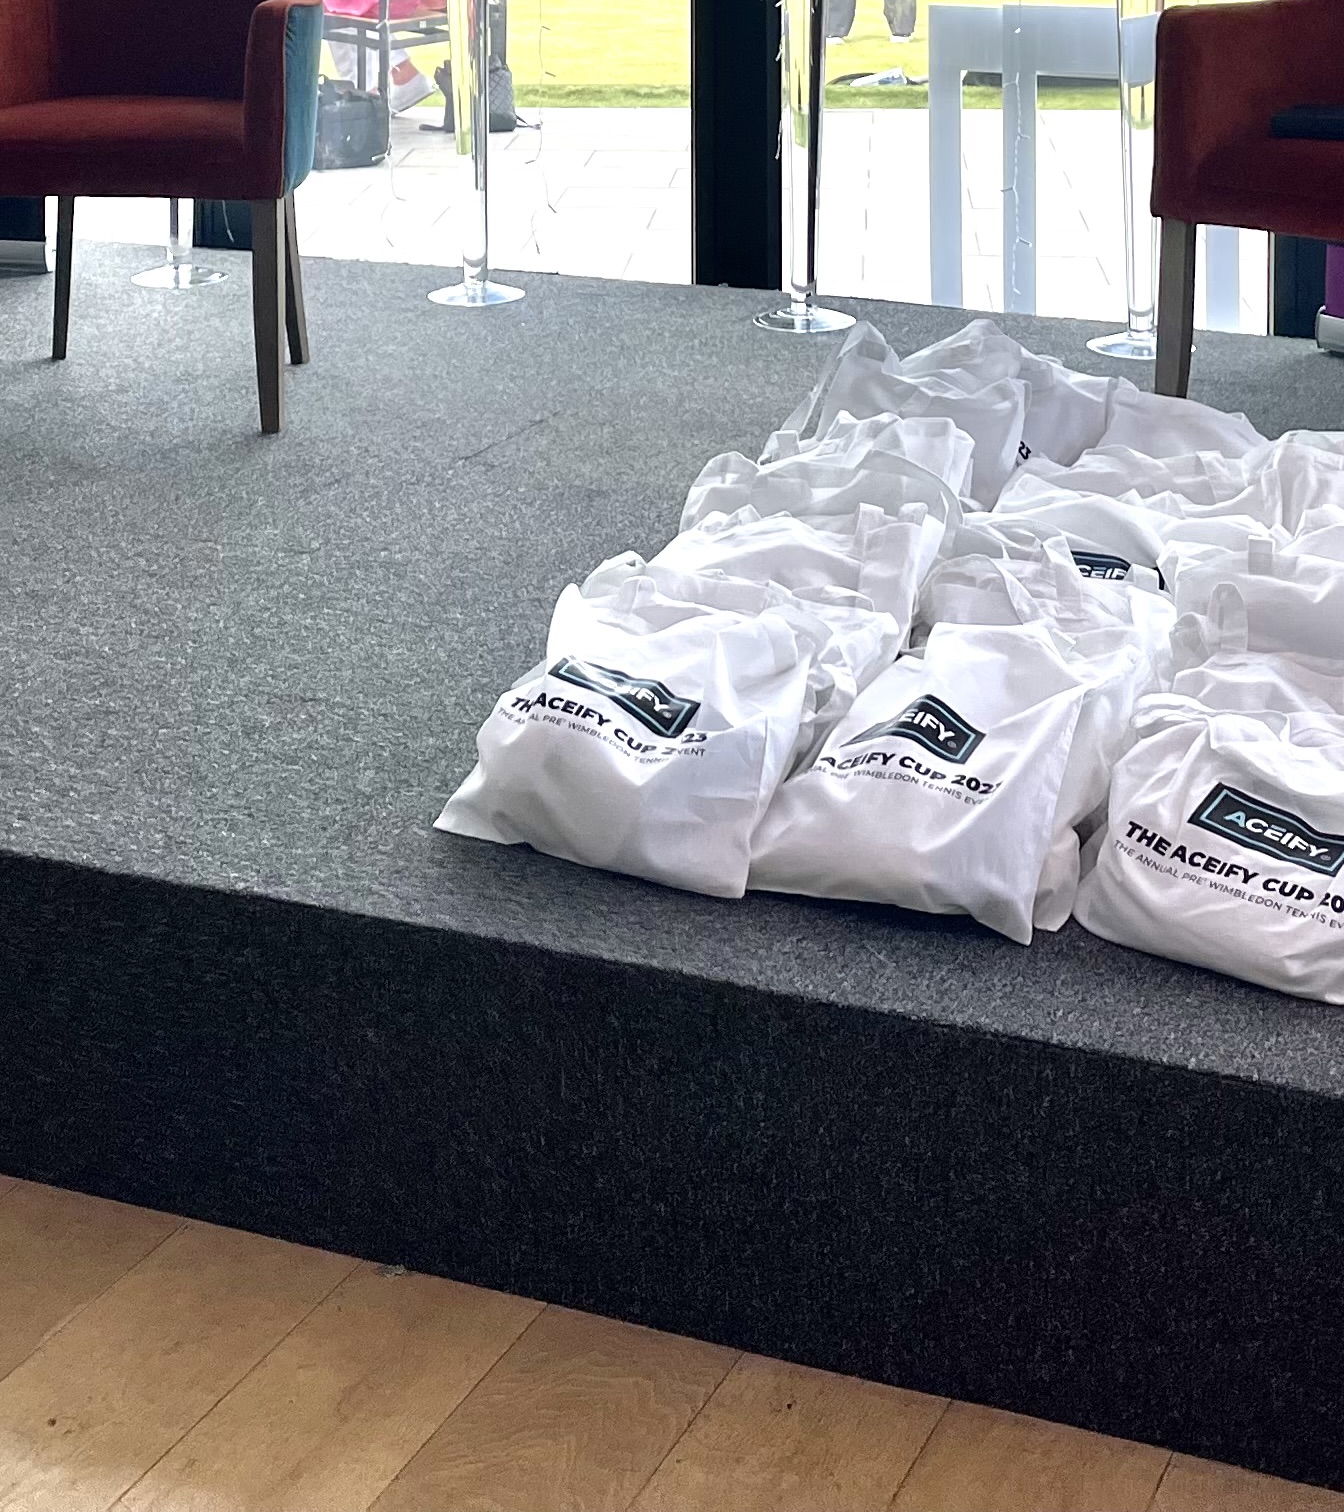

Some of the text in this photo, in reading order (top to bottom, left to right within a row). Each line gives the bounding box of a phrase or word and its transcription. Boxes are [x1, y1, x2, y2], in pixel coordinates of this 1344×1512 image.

[533, 692, 611, 727] ACEIFY
[614, 728, 657, 754] CUP
[854, 770, 919, 784] WIMBLEDON
[899, 755, 947, 781] CUP
[1127, 821, 1172, 857] THE
[1170, 846, 1259, 885] ACEIFY
[1262, 878, 1314, 902] CUP
[1224, 810, 1331, 858] ACEIFY
[1114, 840, 1134, 857] THE
[1135, 854, 1179, 879] ANNUAL
[1209, 880, 1283, 911] WIMBLEDON
